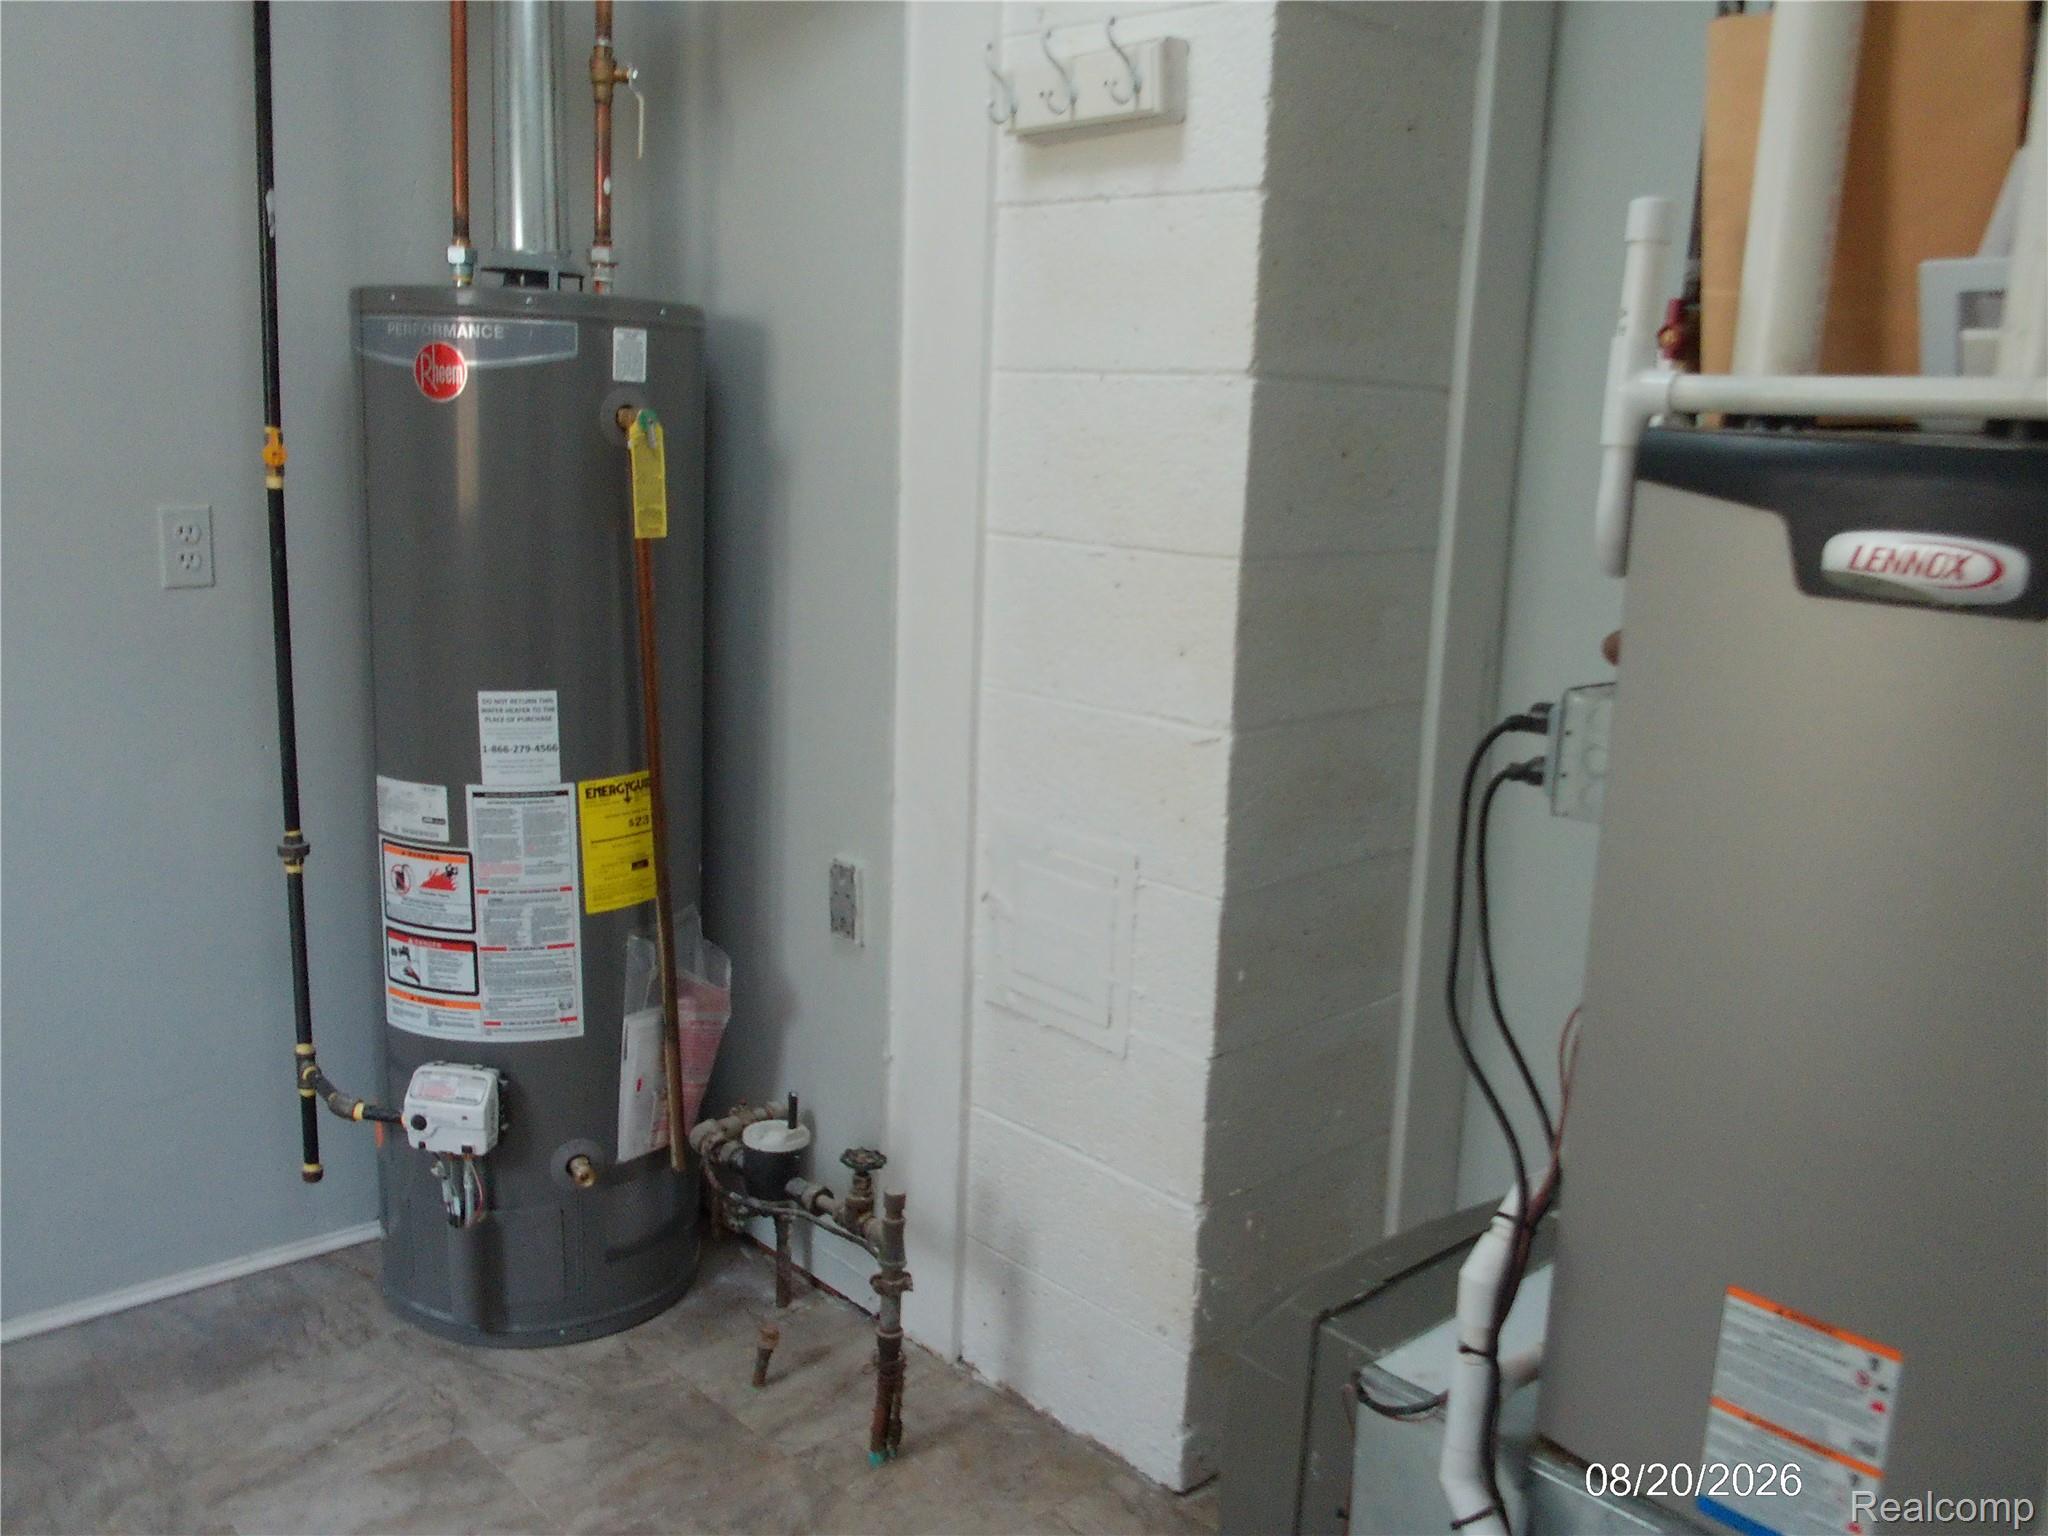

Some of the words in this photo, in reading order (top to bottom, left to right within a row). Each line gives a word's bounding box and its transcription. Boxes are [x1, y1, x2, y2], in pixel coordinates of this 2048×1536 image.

[387, 322, 505, 340] PERFORMANCE
[419, 343, 464, 392] Rheem
[1849, 545, 1972, 581] LENNOX
